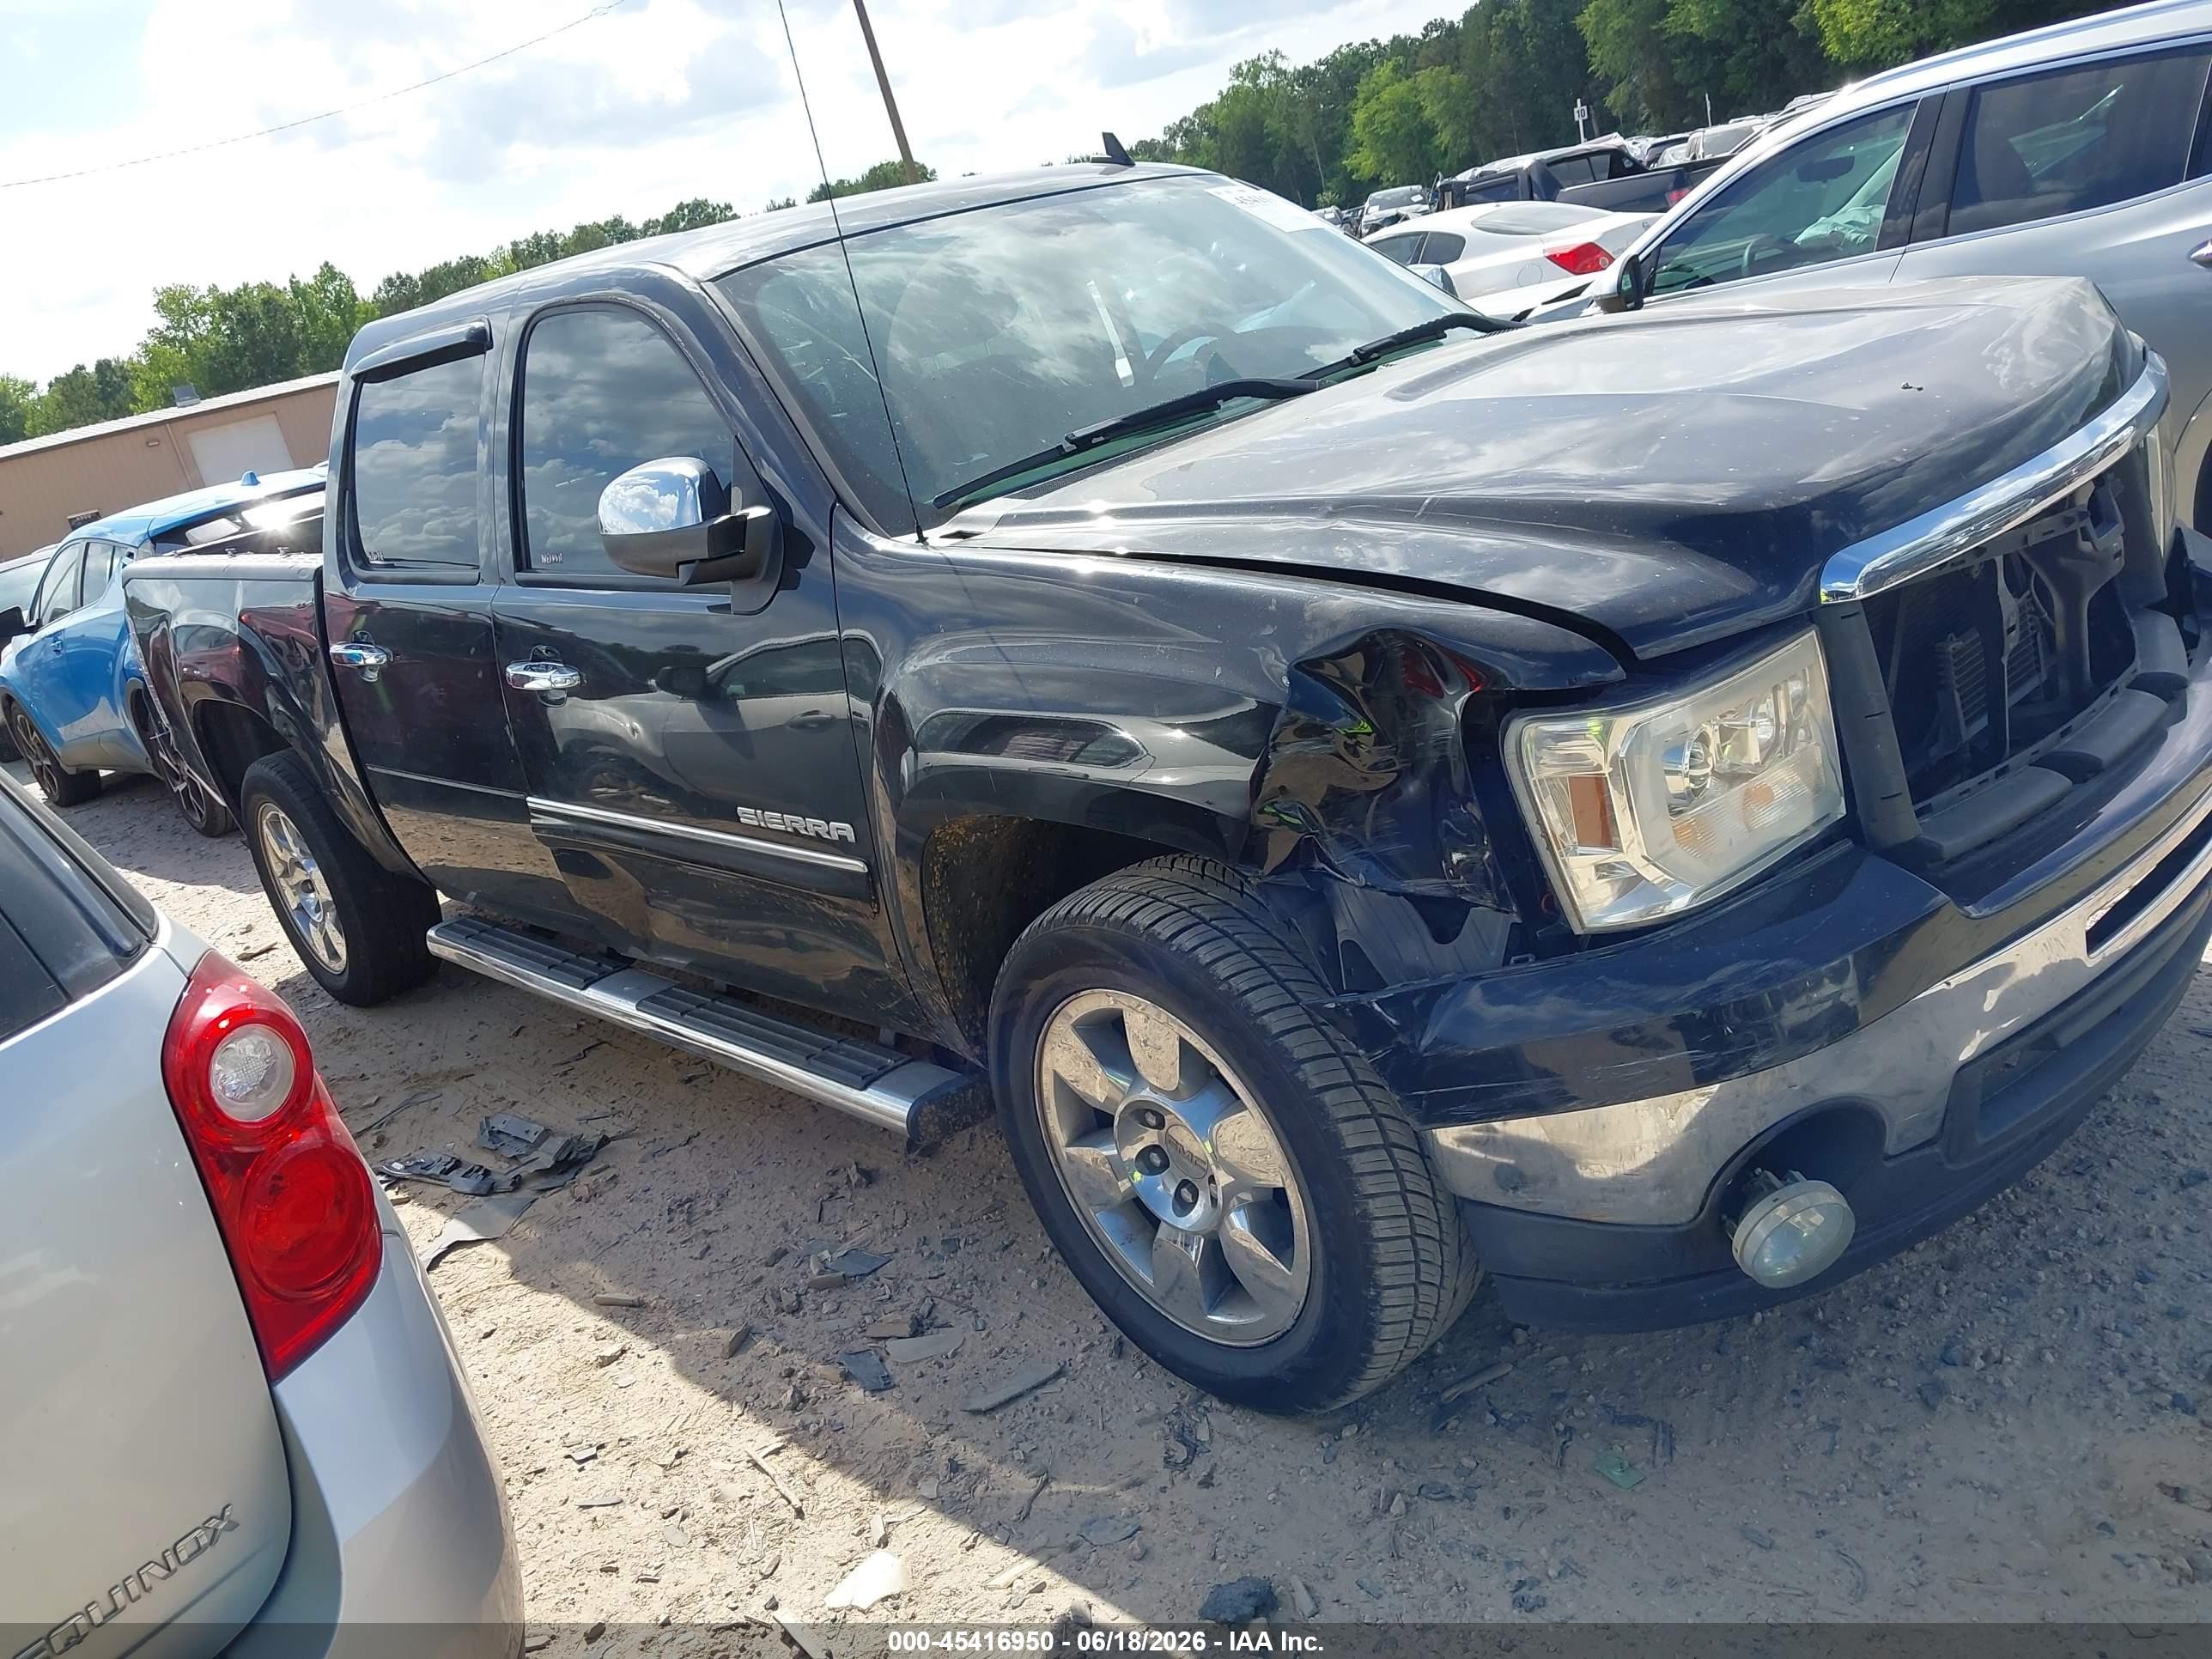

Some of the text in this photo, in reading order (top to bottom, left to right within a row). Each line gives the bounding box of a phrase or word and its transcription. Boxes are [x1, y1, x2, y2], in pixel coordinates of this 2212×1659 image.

[1577, 108, 1586, 118] 10
[737, 806, 856, 843] SIERRA
[1168, 1134, 1206, 1172] GMC
